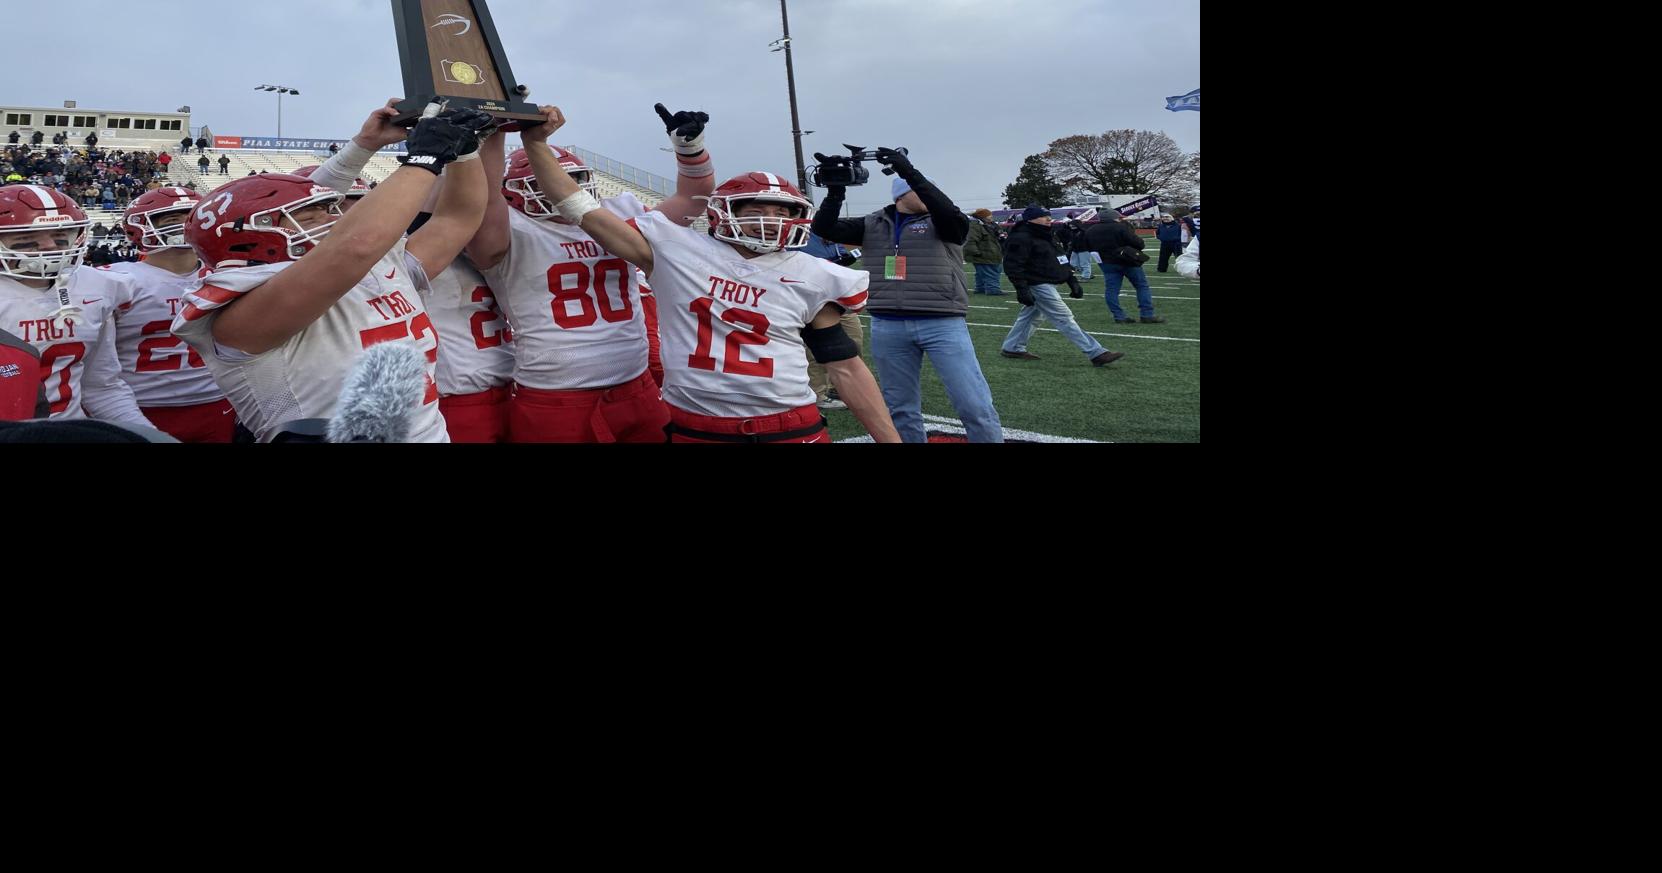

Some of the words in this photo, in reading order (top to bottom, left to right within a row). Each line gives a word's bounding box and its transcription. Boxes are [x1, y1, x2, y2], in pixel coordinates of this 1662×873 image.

[275, 140, 310, 148] STATE
[408, 155, 437, 165] NIKE
[560, 241, 609, 259] TRO
[366, 290, 416, 321] TRO
[546, 258, 634, 329] 80
[708, 275, 767, 308] TROY
[688, 297, 774, 378] 12
